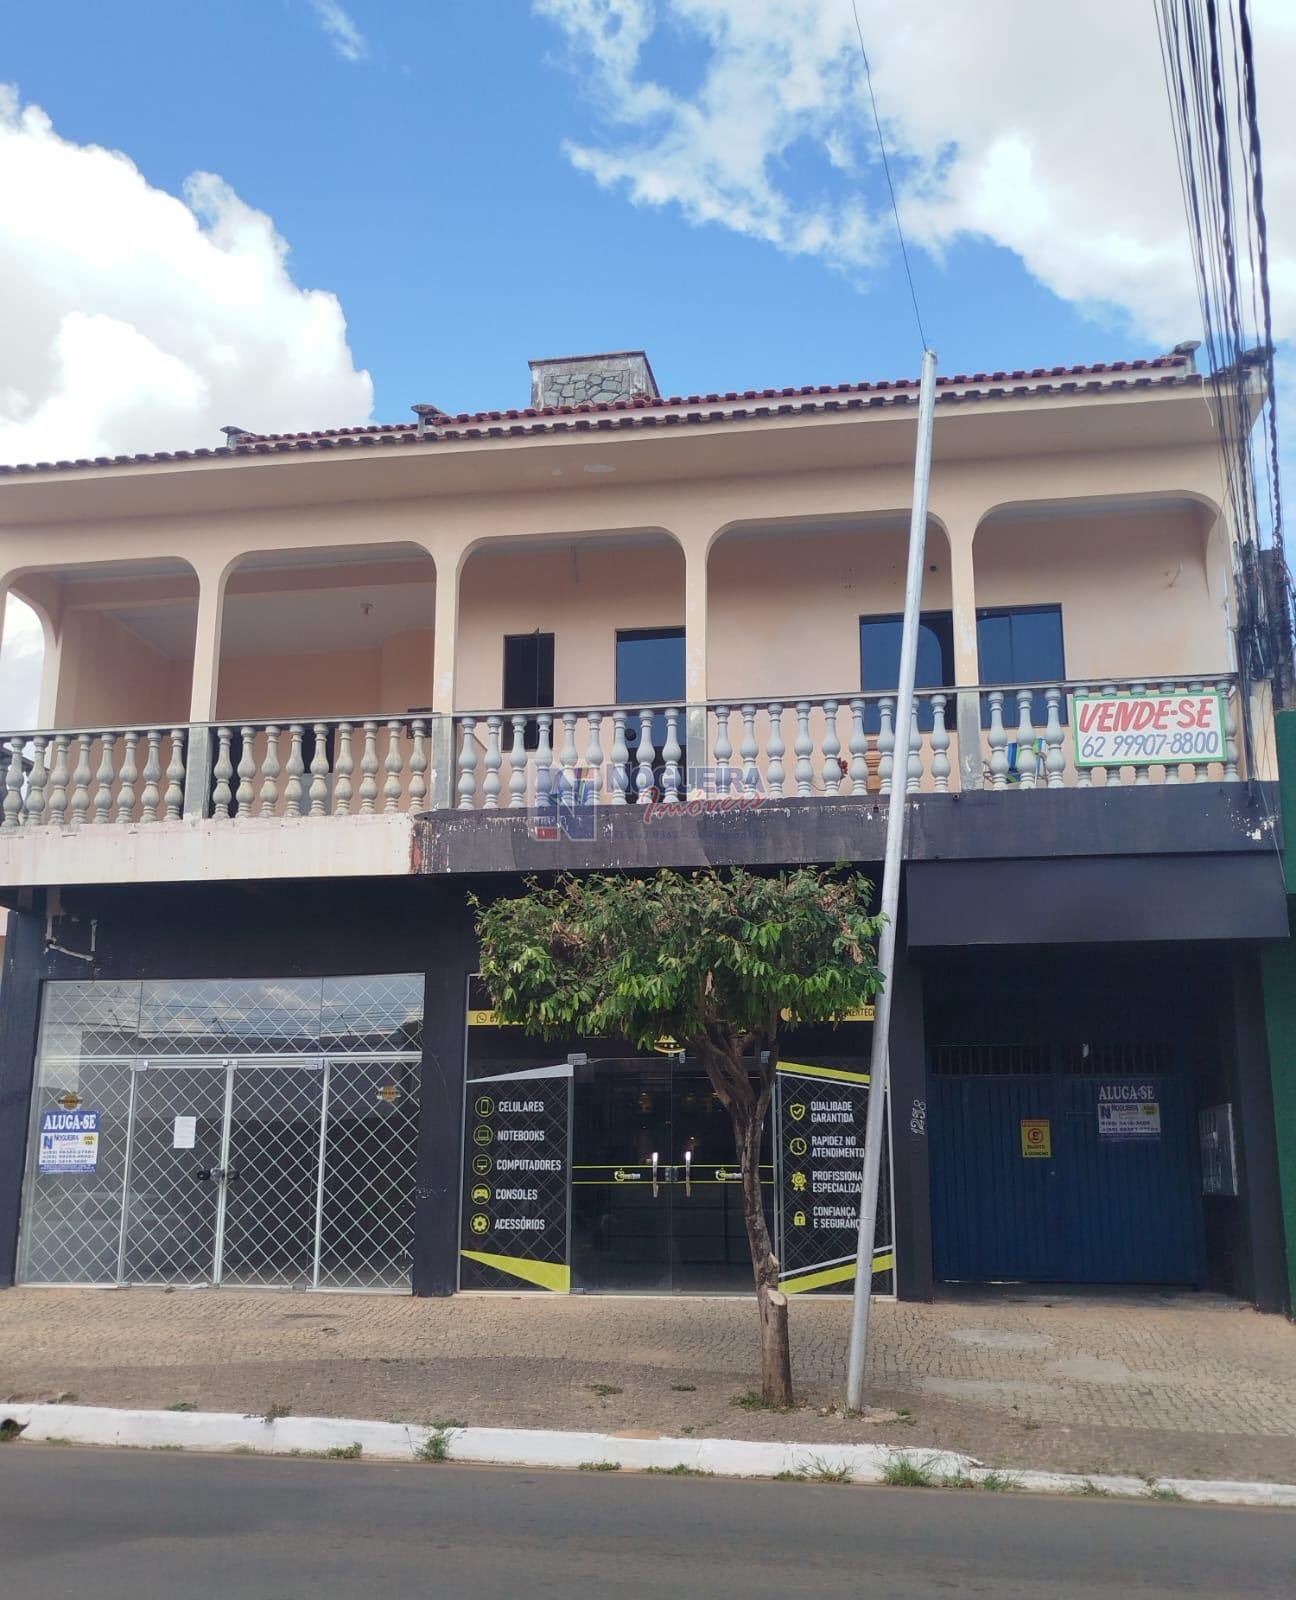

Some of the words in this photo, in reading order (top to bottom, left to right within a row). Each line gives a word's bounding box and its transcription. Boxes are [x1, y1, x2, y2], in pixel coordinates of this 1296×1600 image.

[1079, 698, 1214, 733] VENDE-SE
[1082, 735, 1106, 758] 62
[1111, 731, 1219, 757] 99907-8800
[1099, 1085, 1154, 1100] ALUGA-SE
[498, 1101, 544, 1113] CELULARES
[810, 1101, 852, 1112] QUALIDADE
[43, 1114, 96, 1129] ALUGA-SE
[811, 1112, 854, 1123] GARANTIDA
[497, 1130, 545, 1141] NOTEBOOKS
[811, 1136, 844, 1146] RAPIDEZ
[845, 1136, 857, 1146] NO
[811, 1147, 865, 1158] ATENDIMENTO
[496, 1159, 562, 1171] COMPUTADORES
[812, 1171, 863, 1181] PROFISSIONA
[812, 1182, 863, 1193] ESPECIALIZA
[495, 1189, 538, 1200] CONSOLES
[813, 1206, 856, 1219] CONFIANÇA
[494, 1216, 545, 1230] ACESSÓRIOS
[813, 1219, 820, 1229] E
